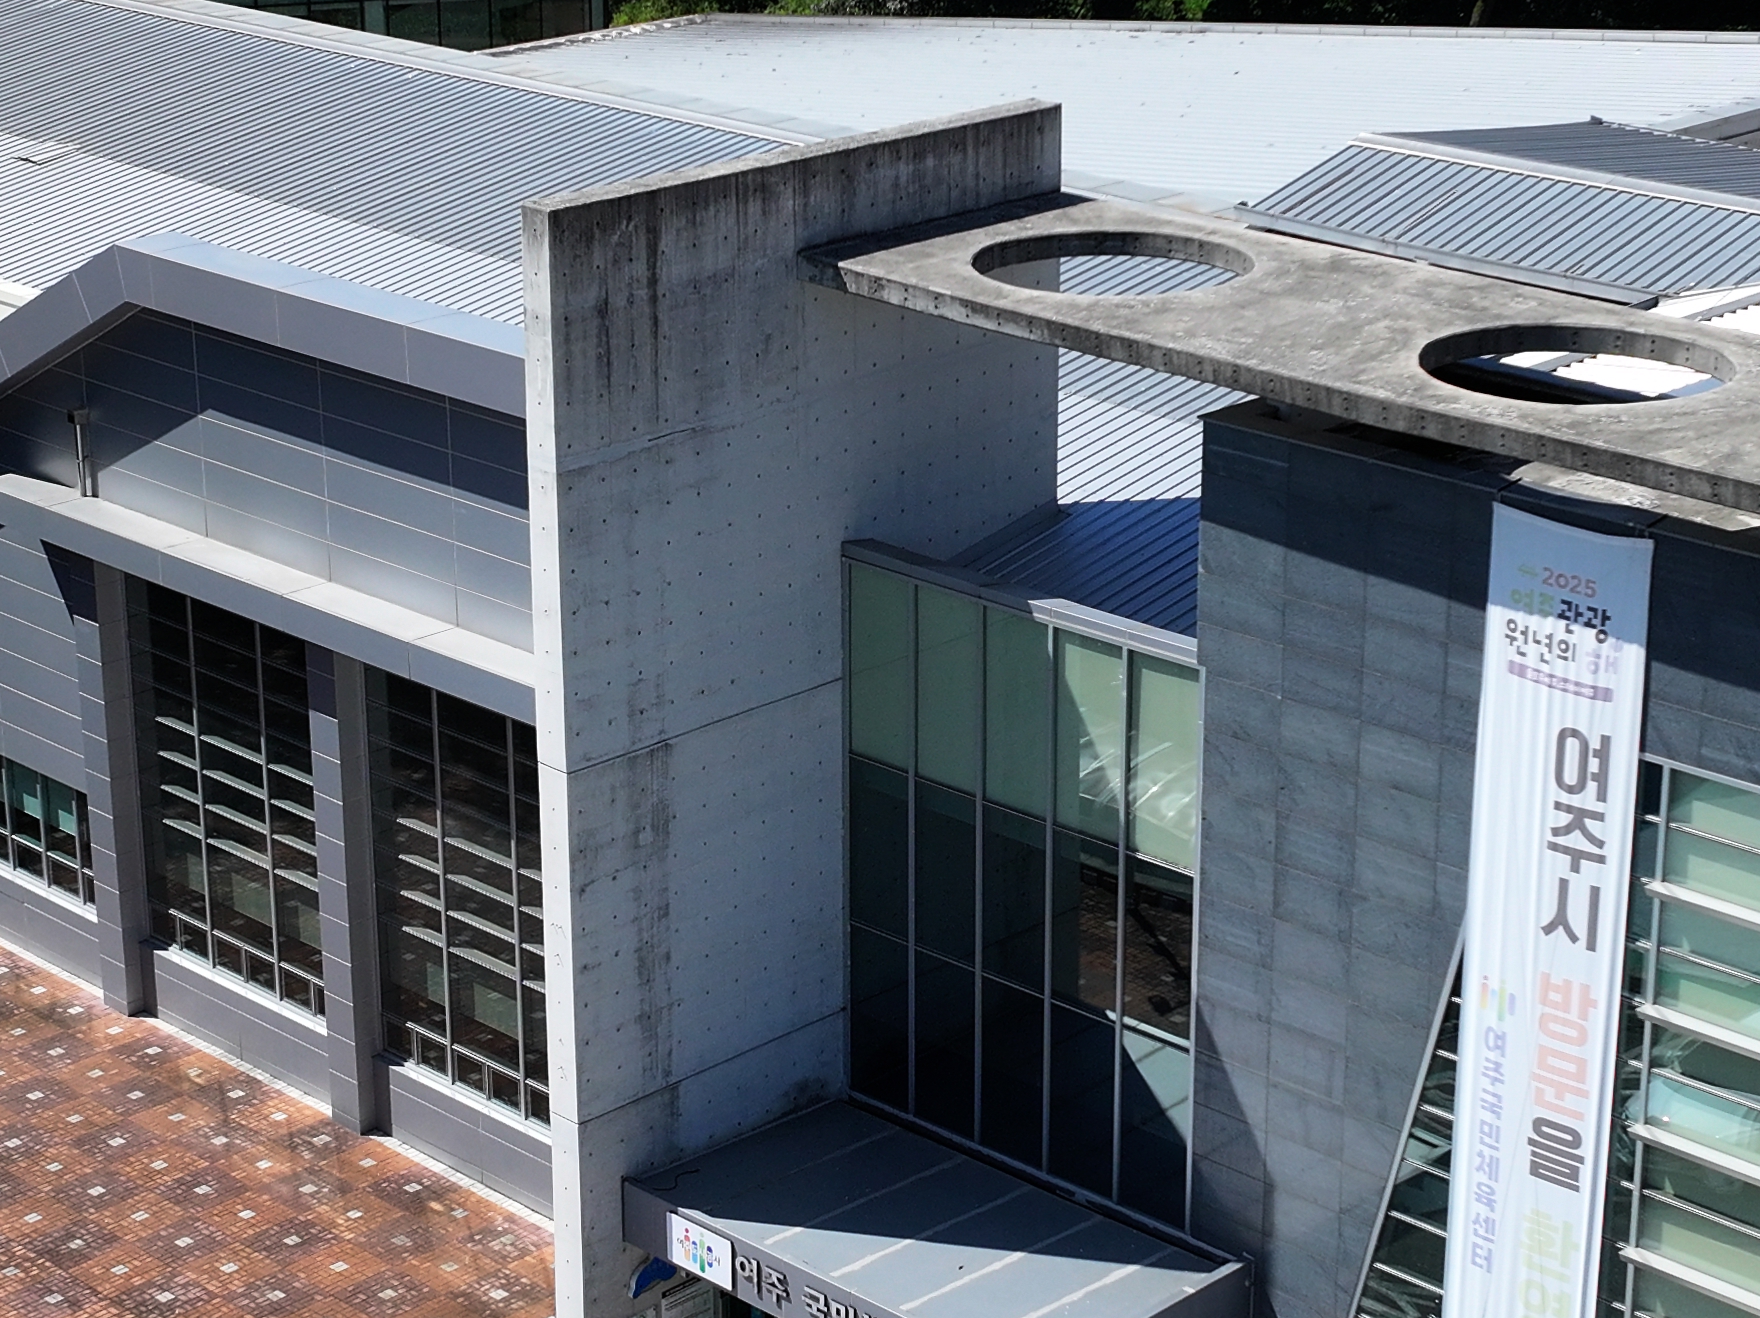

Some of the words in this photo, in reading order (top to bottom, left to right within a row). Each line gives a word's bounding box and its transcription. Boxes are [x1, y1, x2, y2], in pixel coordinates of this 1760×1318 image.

[1542, 566, 1597, 599] 2025
[1505, 618, 1576, 665] 원년의
[1541, 726, 1611, 952] 여주시
[1527, 969, 1598, 1192] 방문을
[735, 1256, 791, 1304] 여주
